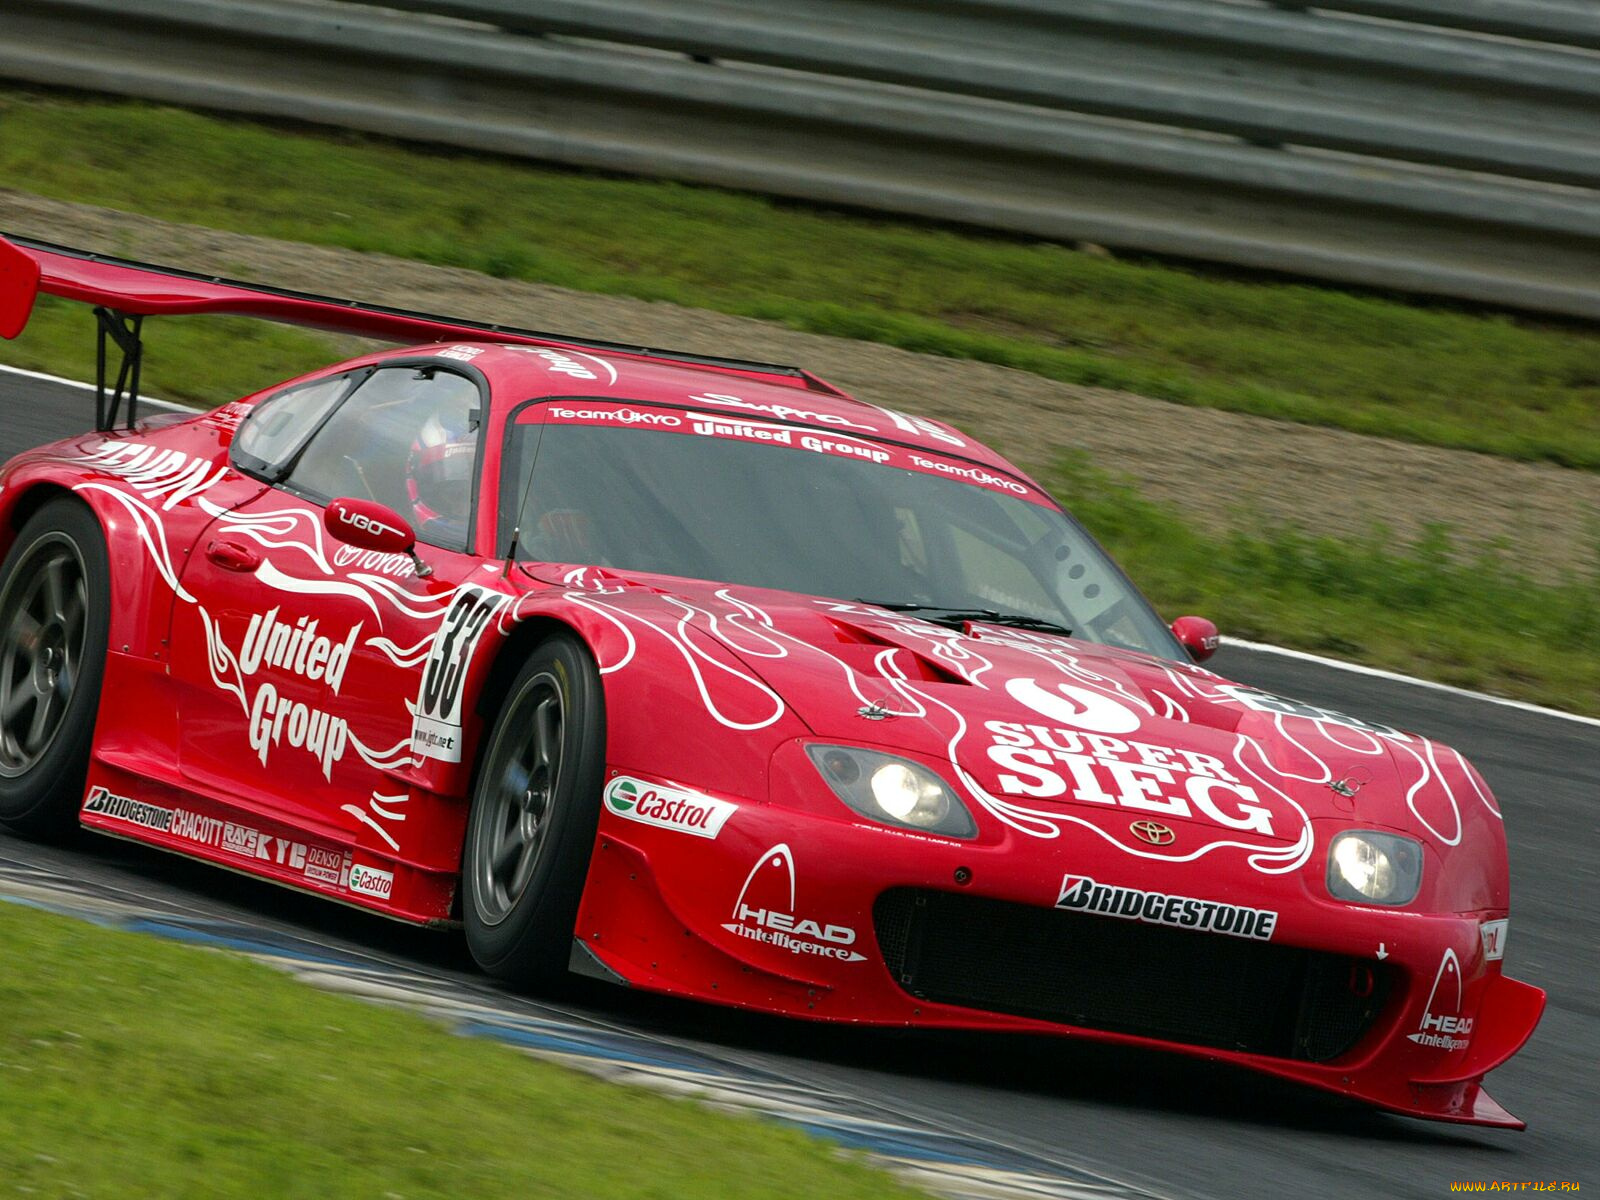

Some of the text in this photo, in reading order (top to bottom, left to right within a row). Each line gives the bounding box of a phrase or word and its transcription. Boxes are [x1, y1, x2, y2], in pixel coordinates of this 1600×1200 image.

[688, 392, 879, 432] Supra
[693, 421, 890, 464] United Group
[339, 507, 405, 537] UGO
[239, 605, 364, 697] United
[424, 588, 502, 720] 33
[250, 683, 348, 784] Group
[984, 719, 1239, 784] SUPER
[85, 788, 173, 830] BRIDGESTONE
[635, 790, 716, 830] Castrol
[987, 745, 1276, 836] SIEG
[172, 808, 223, 846] CHACOTT
[223, 823, 258, 850] RAYS
[256, 833, 307, 869] KYB
[308, 848, 341, 869] DENSO
[738, 904, 856, 945] HEAD
[1057, 878, 1275, 939] BRIDGESTONE
[737, 923, 850, 961] intelligence
[1424, 1013, 1474, 1034] HEAD
